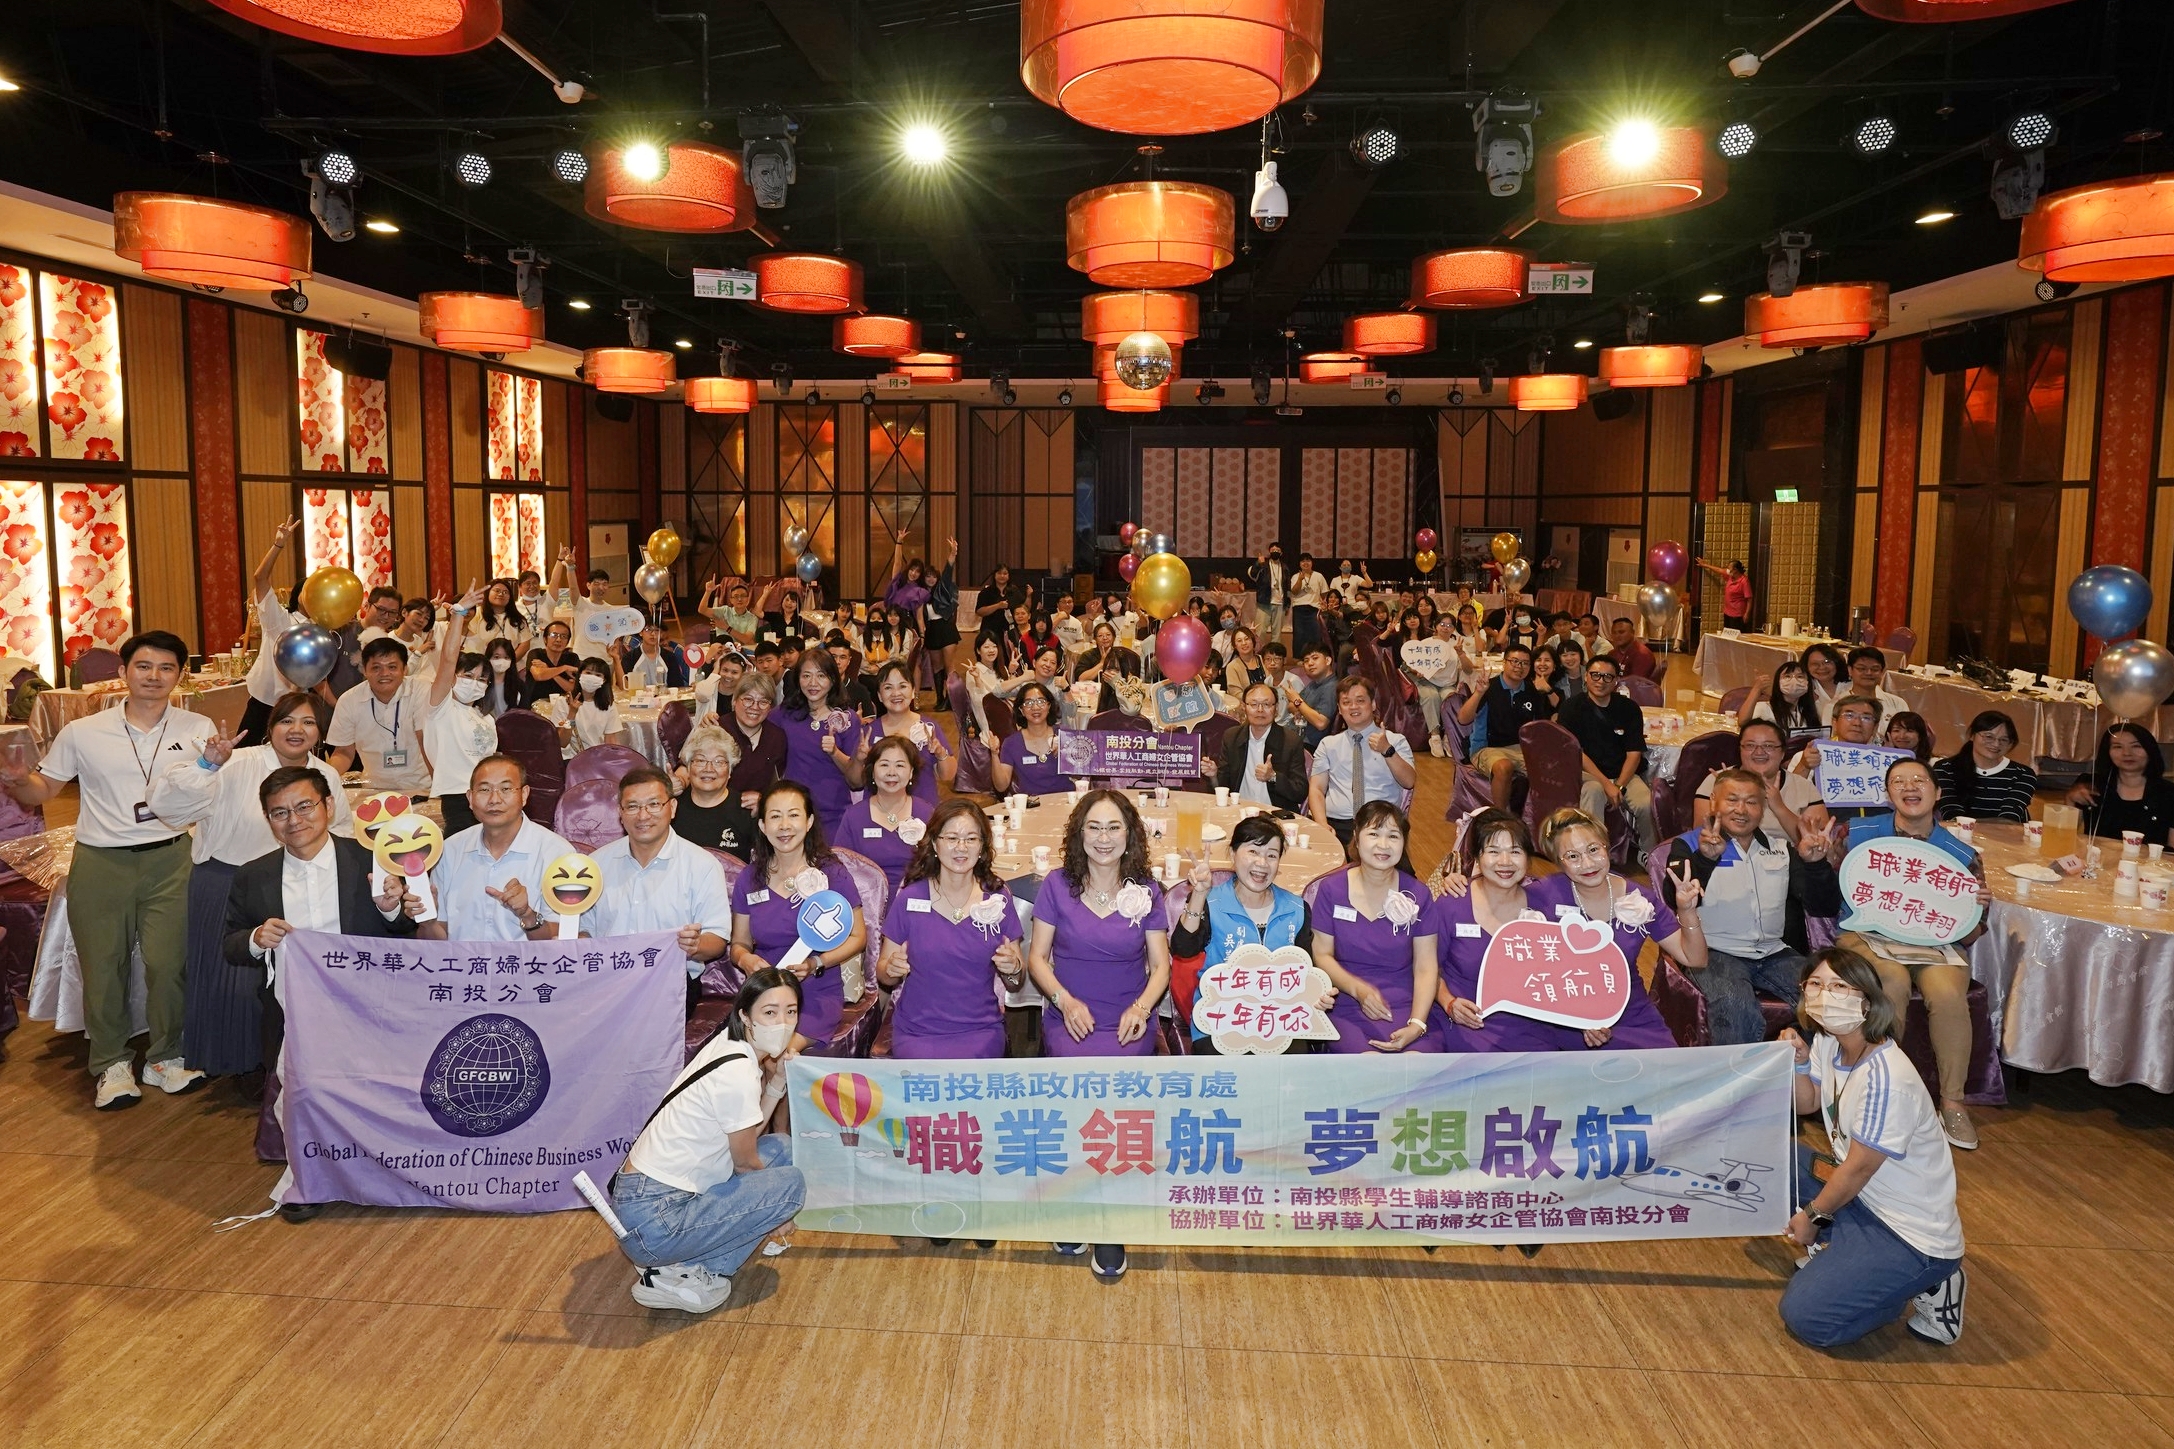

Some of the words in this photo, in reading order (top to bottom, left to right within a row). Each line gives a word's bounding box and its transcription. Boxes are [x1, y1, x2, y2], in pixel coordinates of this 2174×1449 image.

[1106, 735, 1158, 750] 南投分會
[1174, 744, 1193, 752] Chapter
[1867, 849, 1979, 897] 職業領航
[1852, 881, 1957, 938] 夢想飛翔
[322, 947, 662, 975] 世界華人工商婦女企管協會
[1502, 934, 1561, 962] 職業
[429, 983, 558, 1003] 南投分會
[1210, 965, 1304, 997] 十年有成
[1524, 963, 1616, 1003] 領航員
[1206, 1003, 1309, 1038] 十年有你
[458, 1069, 513, 1083] GFCBW
[902, 1070, 1238, 1103] 南投縣政府教育處
[303, 1141, 358, 1161] Global
[361, 1147, 445, 1170] deration
[450, 1147, 469, 1167] of
[471, 1146, 533, 1166] Chinese
[536, 1147, 602, 1166] Business
[605, 1137, 637, 1155] Wo
[905, 1108, 1243, 1176] 職業領航
[1304, 1105, 1655, 1181] 夢想啟航
[485, 1177, 560, 1199] Chapter
